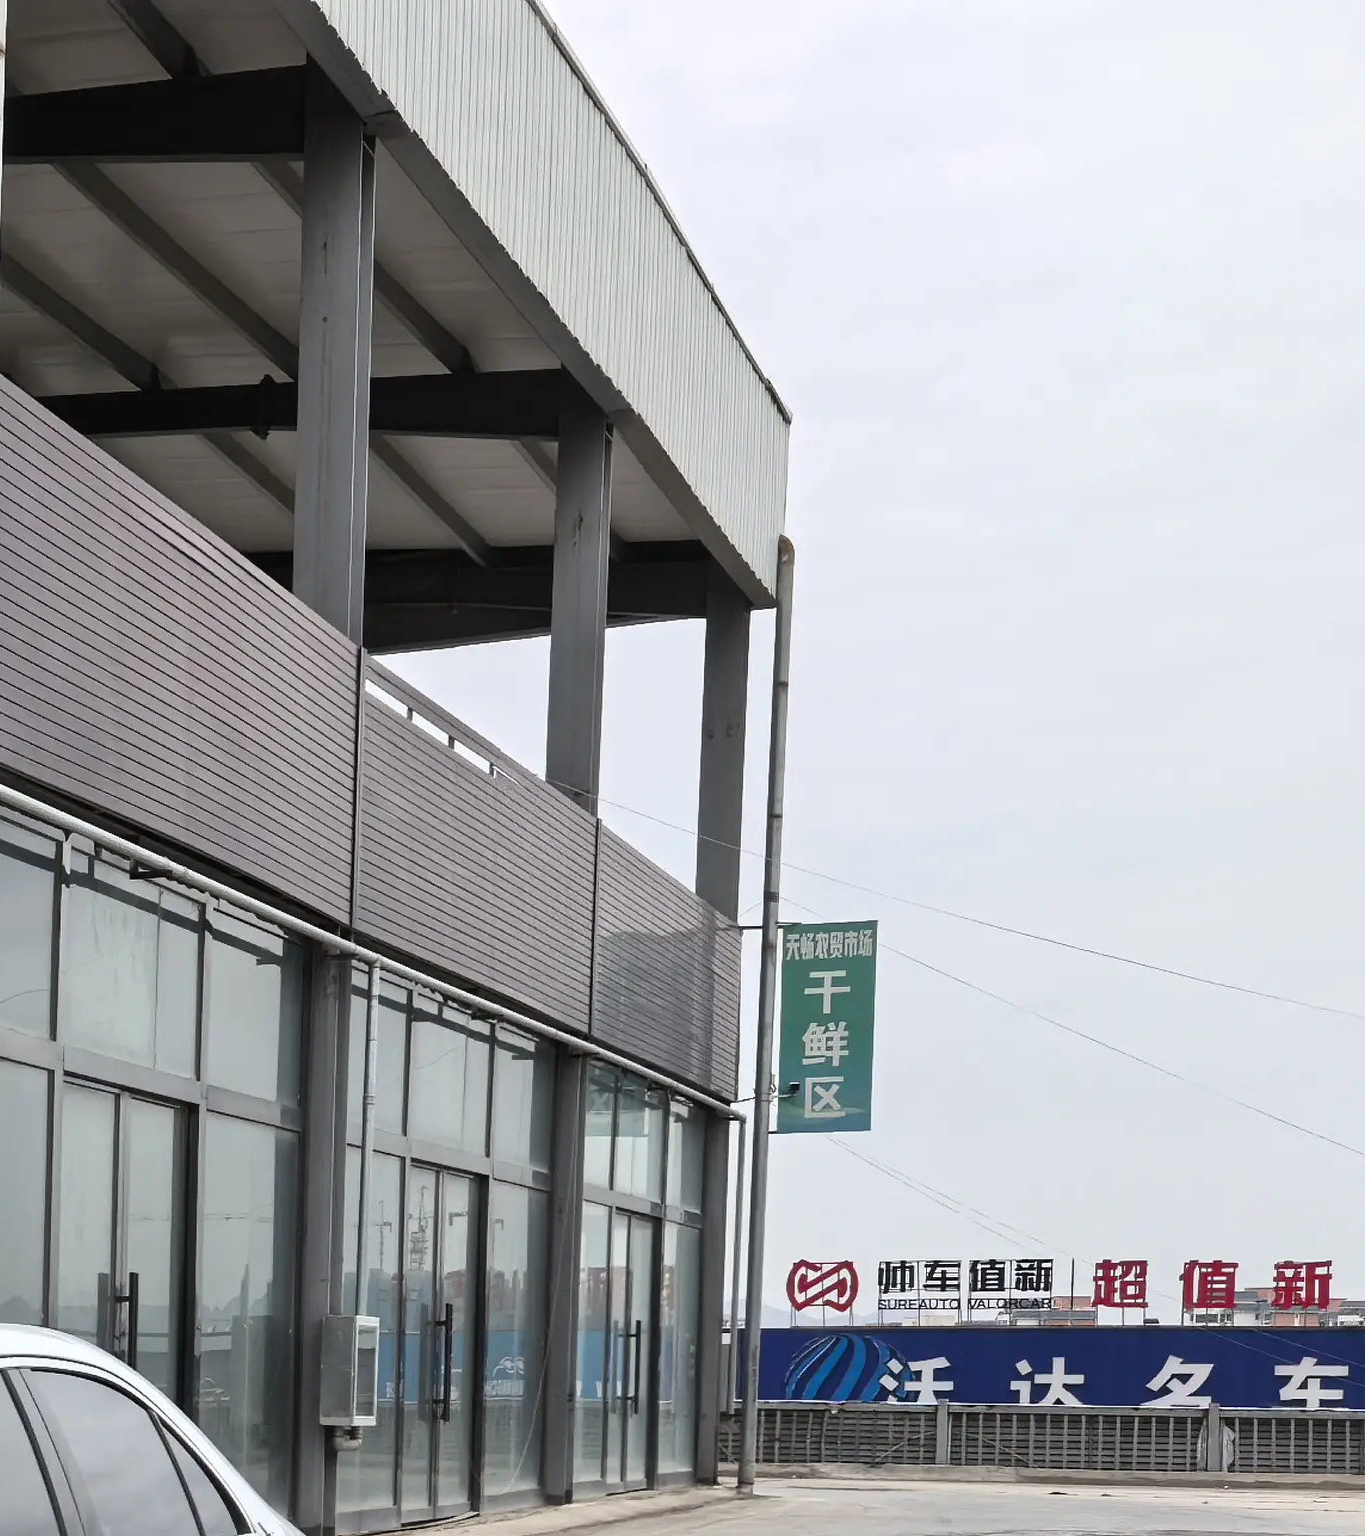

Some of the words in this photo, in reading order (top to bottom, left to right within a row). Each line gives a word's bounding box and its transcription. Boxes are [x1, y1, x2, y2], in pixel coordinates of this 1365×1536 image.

[802, 969, 851, 1119] 干鲜区
[877, 1258, 1053, 1294] 帅车值新
[1092, 1258, 1333, 1311] 超值新
[877, 1298, 961, 1310] SUREAUTO
[878, 1354, 1350, 1409] 沃达名车
